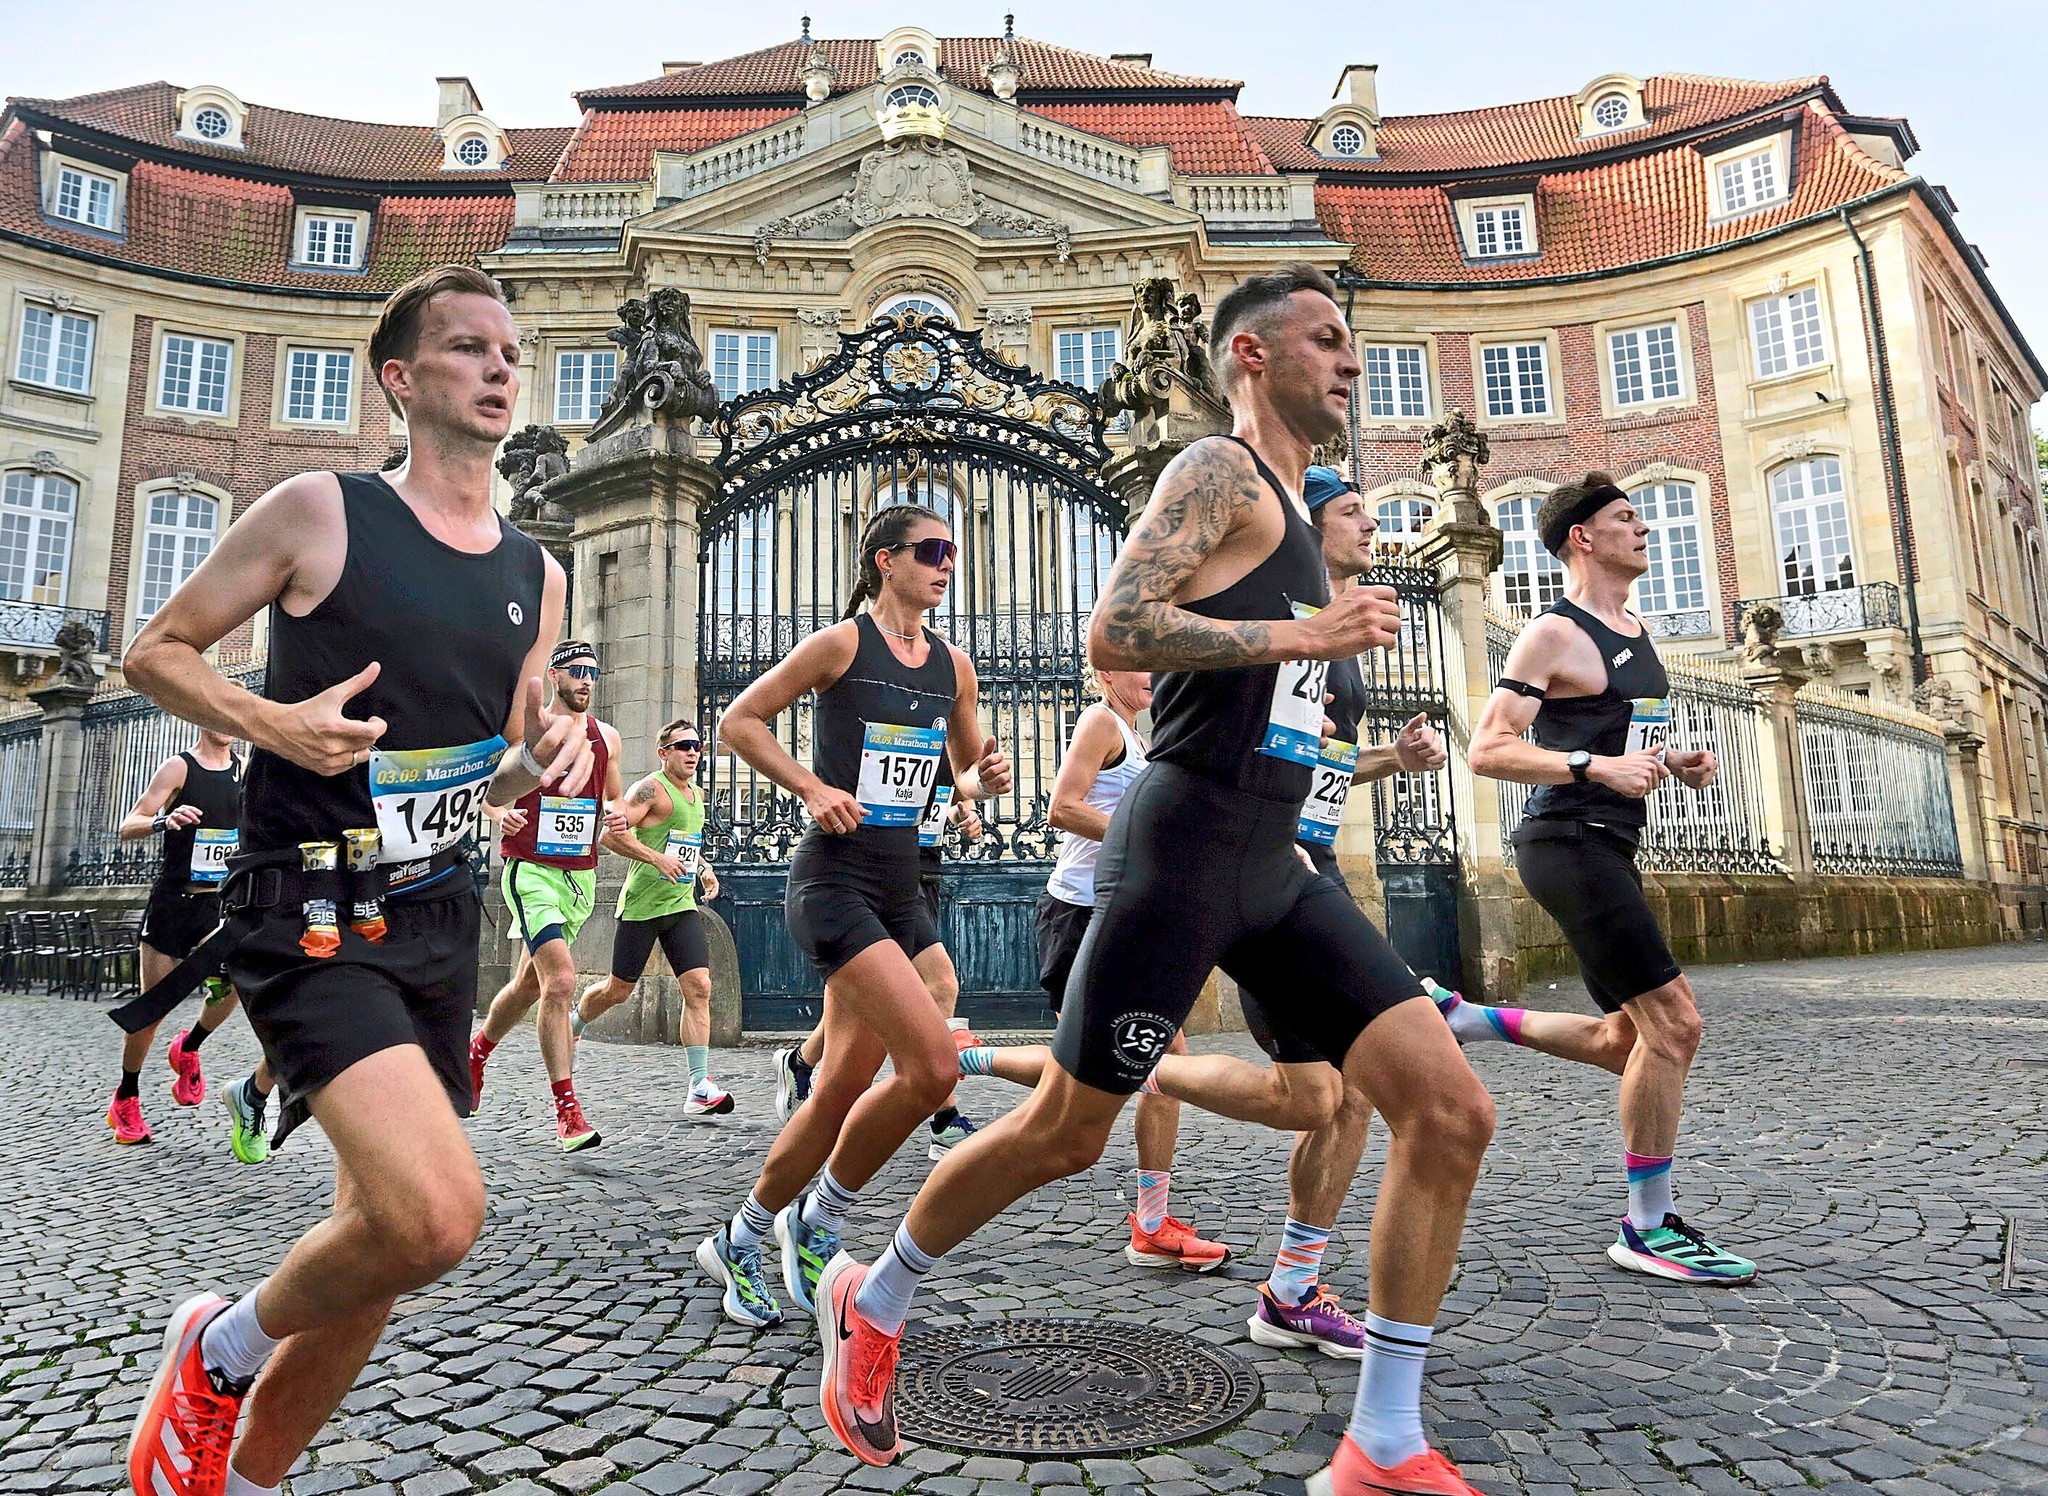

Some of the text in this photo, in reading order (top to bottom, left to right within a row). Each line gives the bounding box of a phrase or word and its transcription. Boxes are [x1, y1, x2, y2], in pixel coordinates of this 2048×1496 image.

[1611, 647, 1635, 668] HOKA
[1292, 660, 1327, 703] 23
[869, 734, 893, 745] 03.09.
[893, 737, 929, 749] Marathon
[376, 768, 421, 785] 03.09.
[425, 760, 484, 782] Marathon
[879, 755, 933, 788] 1570
[895, 788, 914, 800] Katja
[396, 780, 491, 845] 1493
[554, 814, 585, 833] 535
[678, 846, 697, 863] 921
[1125, 1023, 1165, 1059] LSF
